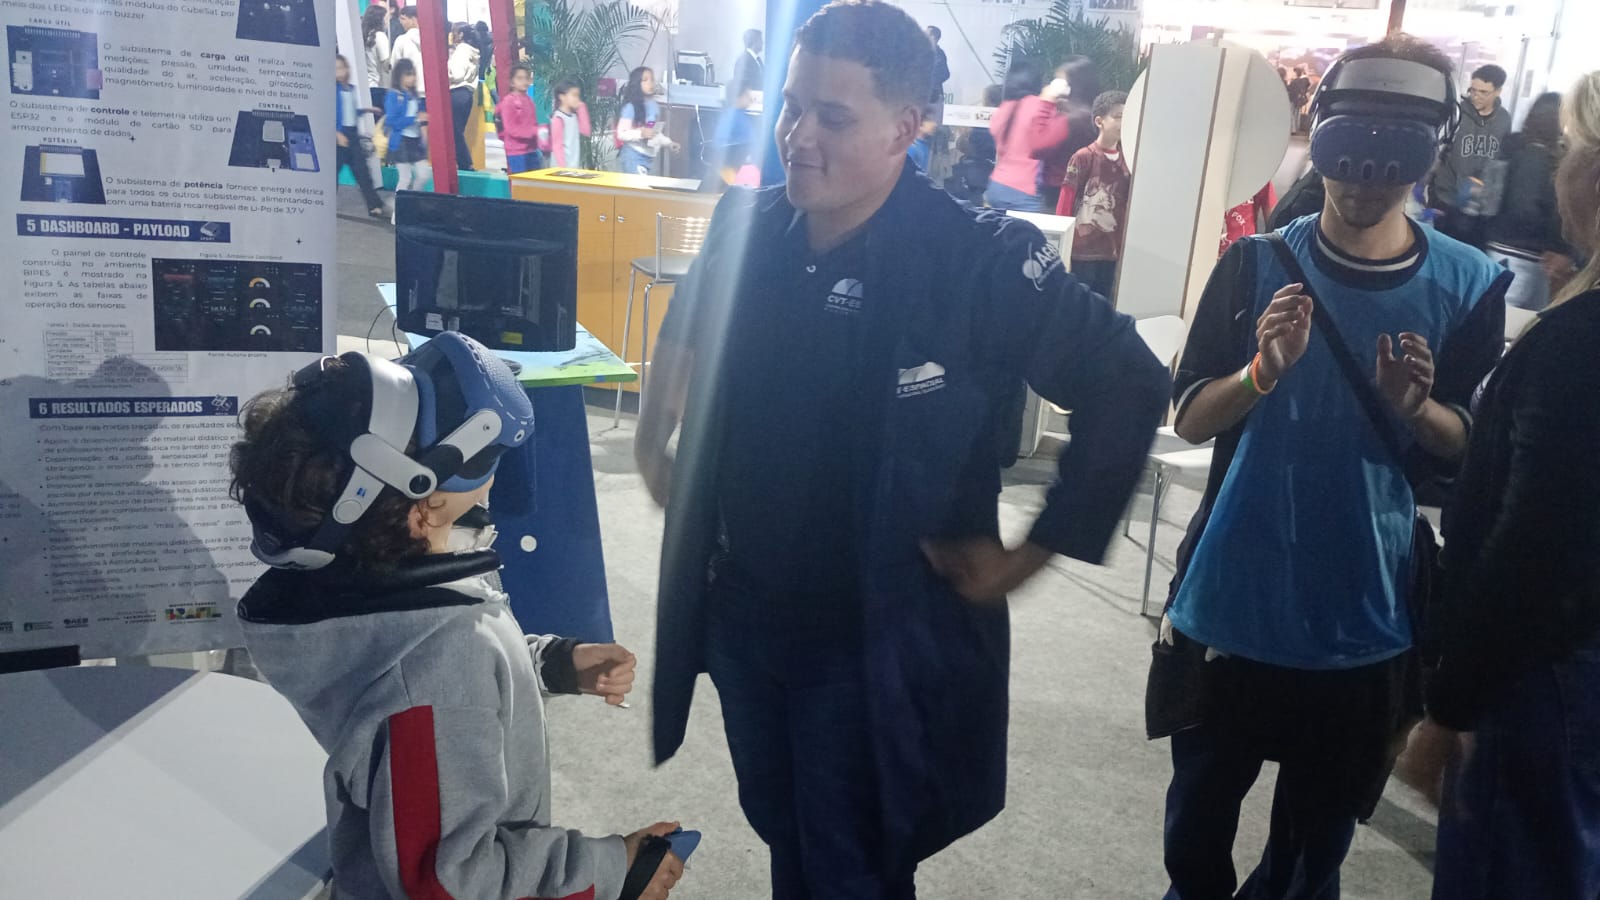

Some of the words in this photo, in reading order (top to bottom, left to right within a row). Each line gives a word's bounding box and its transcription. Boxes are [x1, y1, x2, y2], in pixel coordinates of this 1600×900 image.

[181, 5, 218, 16] CubeSat
[120, 45, 171, 55] subsistema
[200, 51, 226, 61] carga
[234, 54, 250, 62] útil
[258, 57, 285, 65] realiza
[104, 66, 150, 76] qualidade
[177, 80, 236, 94] luminosidade
[245, 88, 265, 97] nível
[21, 102, 74, 112] subsistema
[90, 106, 130, 115] controle
[140, 110, 186, 120] telemetria
[188, 112, 214, 121] utiliza
[10, 112, 40, 120] ESP32
[84, 116, 120, 126] módulo
[151, 121, 180, 130] cartão
[213, 126, 232, 134] para
[1461, 134, 1500, 159] GAP
[116, 177, 167, 187] subsistema
[184, 181, 223, 189] potência
[226, 183, 258, 191] fornece
[260, 186, 292, 194] energia
[172, 191, 200, 199] outros
[151, 200, 181, 208] bateria
[183, 203, 236, 211] recarregável
[1231, 211, 1246, 226] FOX
[26, 219, 36, 232] 5
[40, 219, 120, 236] DASHBOARD
[134, 223, 190, 238] PAYLOAD
[63, 249, 91, 258] painel
[110, 250, 147, 258] controle
[22, 259, 72, 267] construído
[104, 261, 147, 269] ambiente
[81, 271, 124, 279] mostrado
[24, 280, 53, 288] Figura
[82, 281, 115, 289] tabelas
[118, 282, 148, 290] abaixo
[97, 291, 122, 299] faixas
[39, 401, 47, 414] 6
[52, 401, 130, 414] RESULTADOS
[134, 400, 203, 413] ESPERADOS
